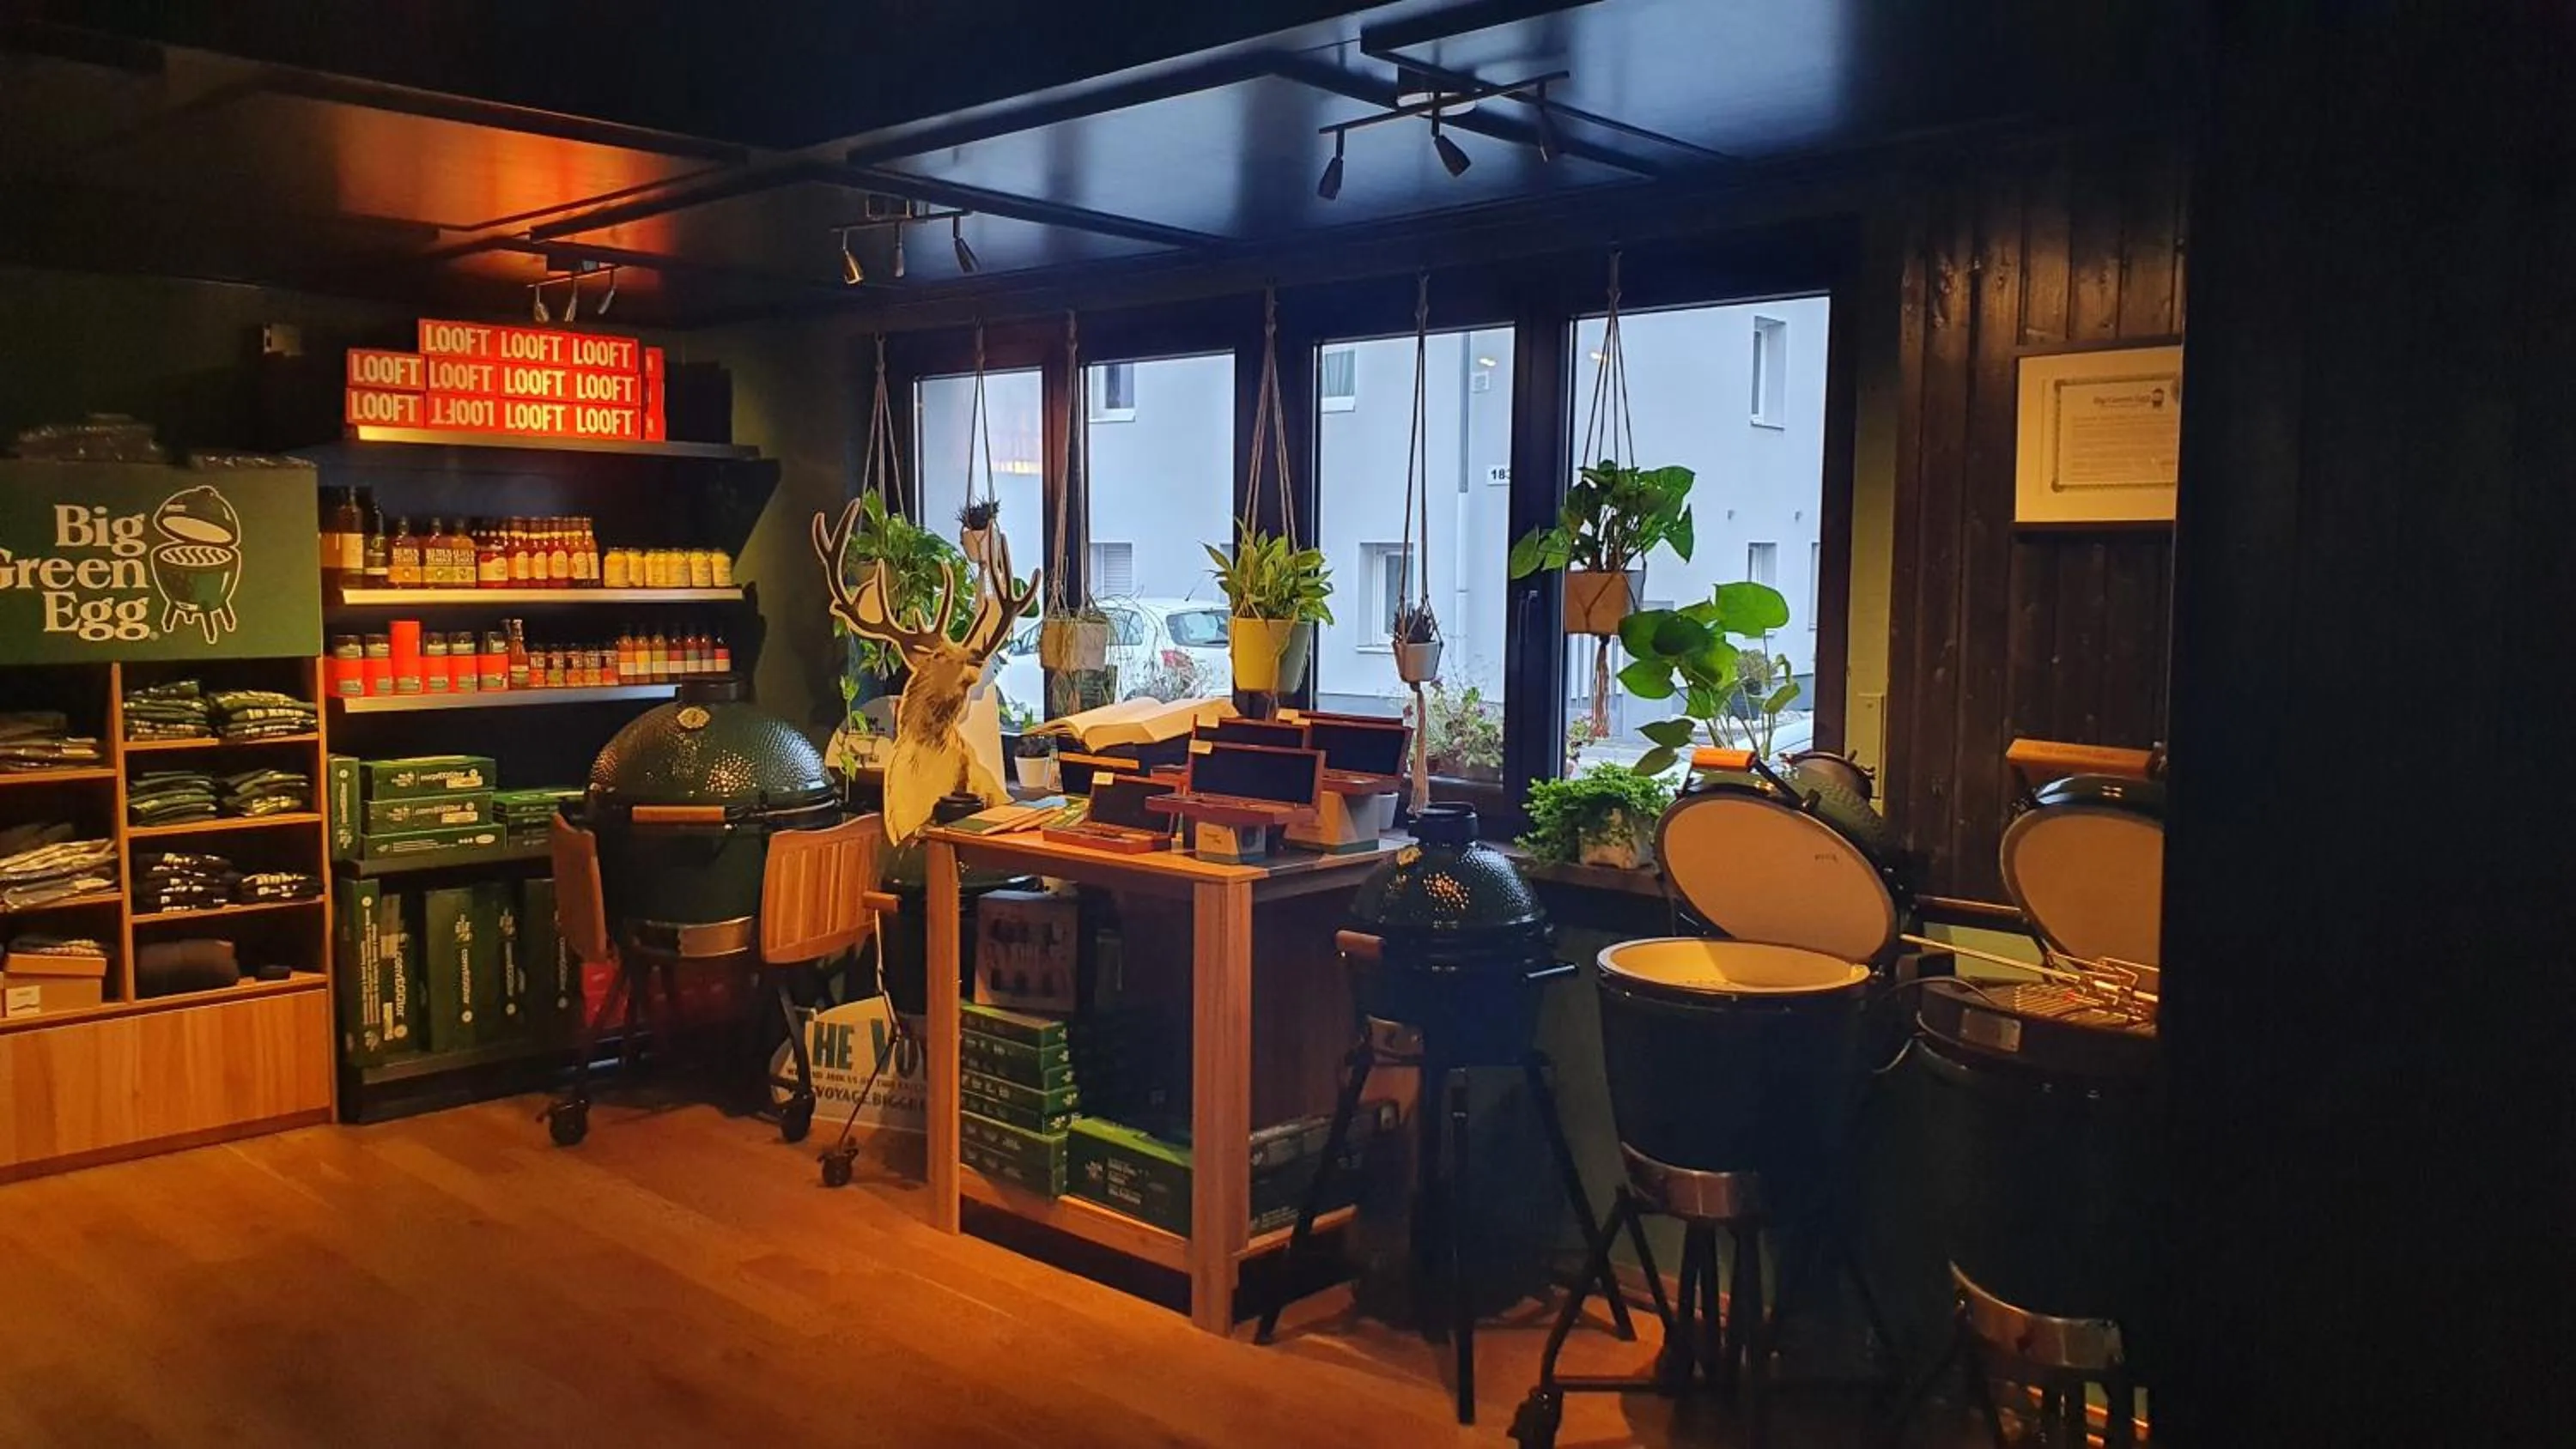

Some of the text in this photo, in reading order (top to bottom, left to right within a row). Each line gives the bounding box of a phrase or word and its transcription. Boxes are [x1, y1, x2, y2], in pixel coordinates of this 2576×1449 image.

[425, 324, 491, 355] LOOFT
[501, 330, 562, 362] LOOFT
[573, 336, 633, 368] LOOFT
[352, 355, 421, 385] LOOFT
[430, 361, 494, 392] LOOFT
[504, 367, 566, 397] LOOFT
[576, 373, 635, 403] LOOFT
[350, 392, 418, 423] LOOFT
[431, 397, 495, 427] LOOFT
[505, 403, 566, 432] LOOFT
[576, 407, 635, 435] LOOFT
[54, 504, 148, 557] Big
[43, 591, 151, 642] Egg
